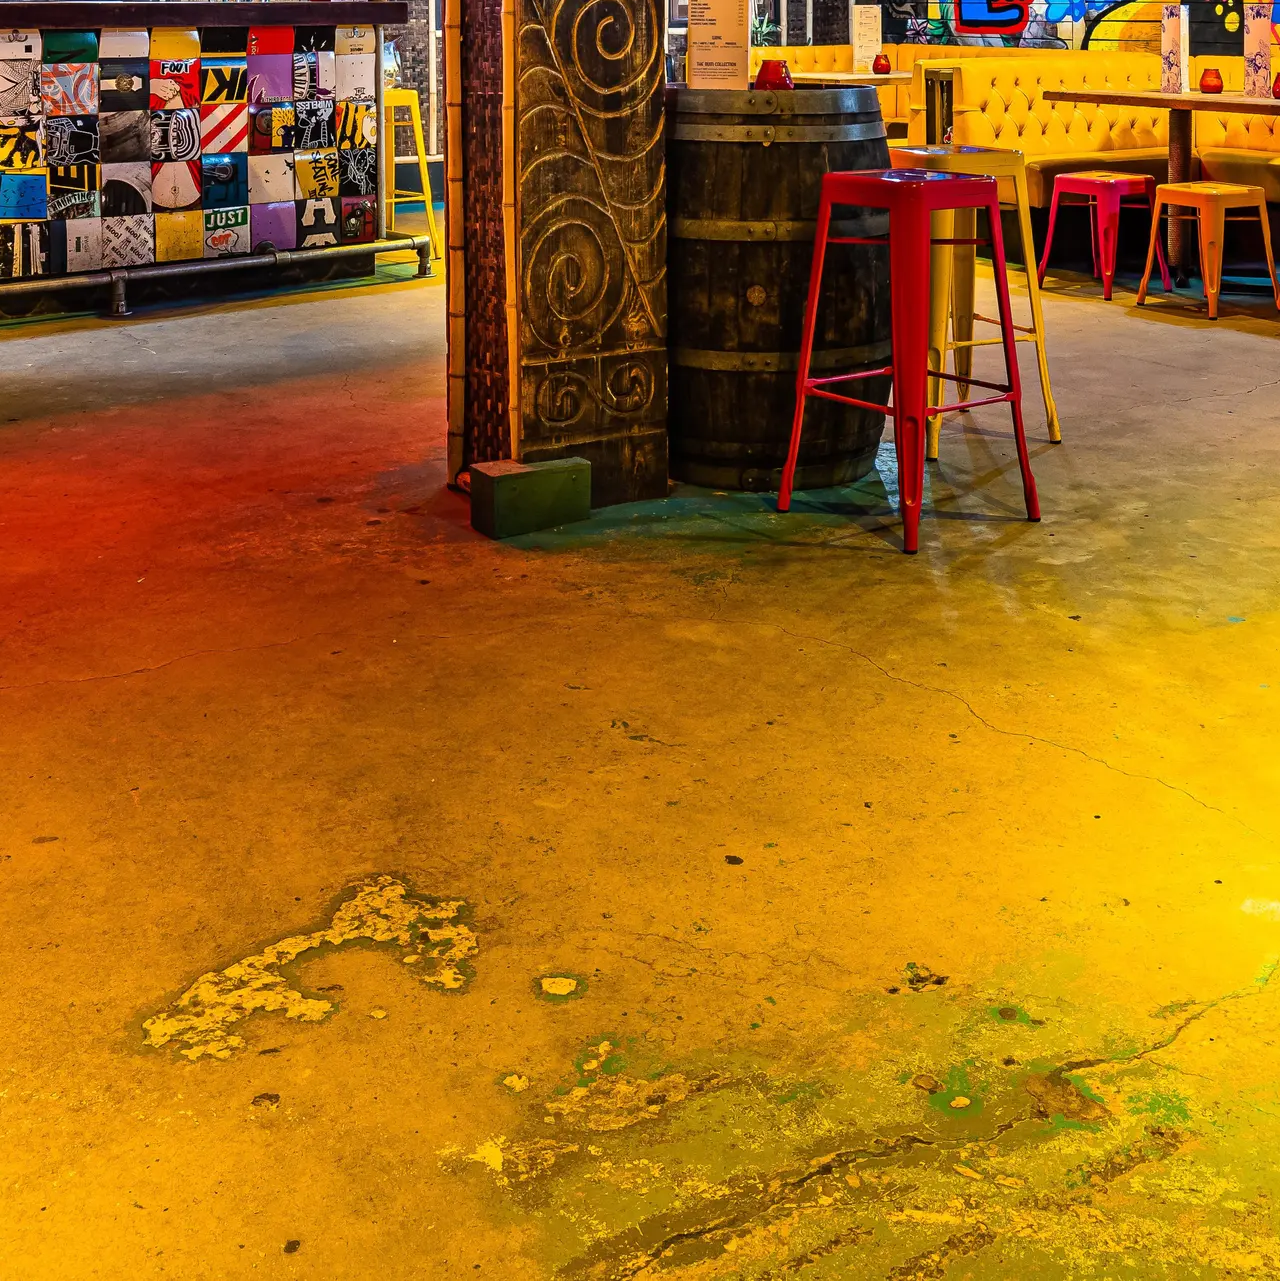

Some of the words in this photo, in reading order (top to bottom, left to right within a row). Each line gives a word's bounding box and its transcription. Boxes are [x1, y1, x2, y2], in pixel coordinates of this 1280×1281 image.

[160, 61, 191, 76] FOOT
[295, 100, 333, 110] WIRELESS
[308, 150, 335, 197] SKATING
[324, 152, 340, 182] GONE
[206, 209, 245, 228] JUST
[105, 225, 121, 240] stool
[124, 225, 141, 240] stool
[143, 225, 155, 238] stoo
[111, 246, 127, 261] stool
[130, 246, 145, 261] stool
